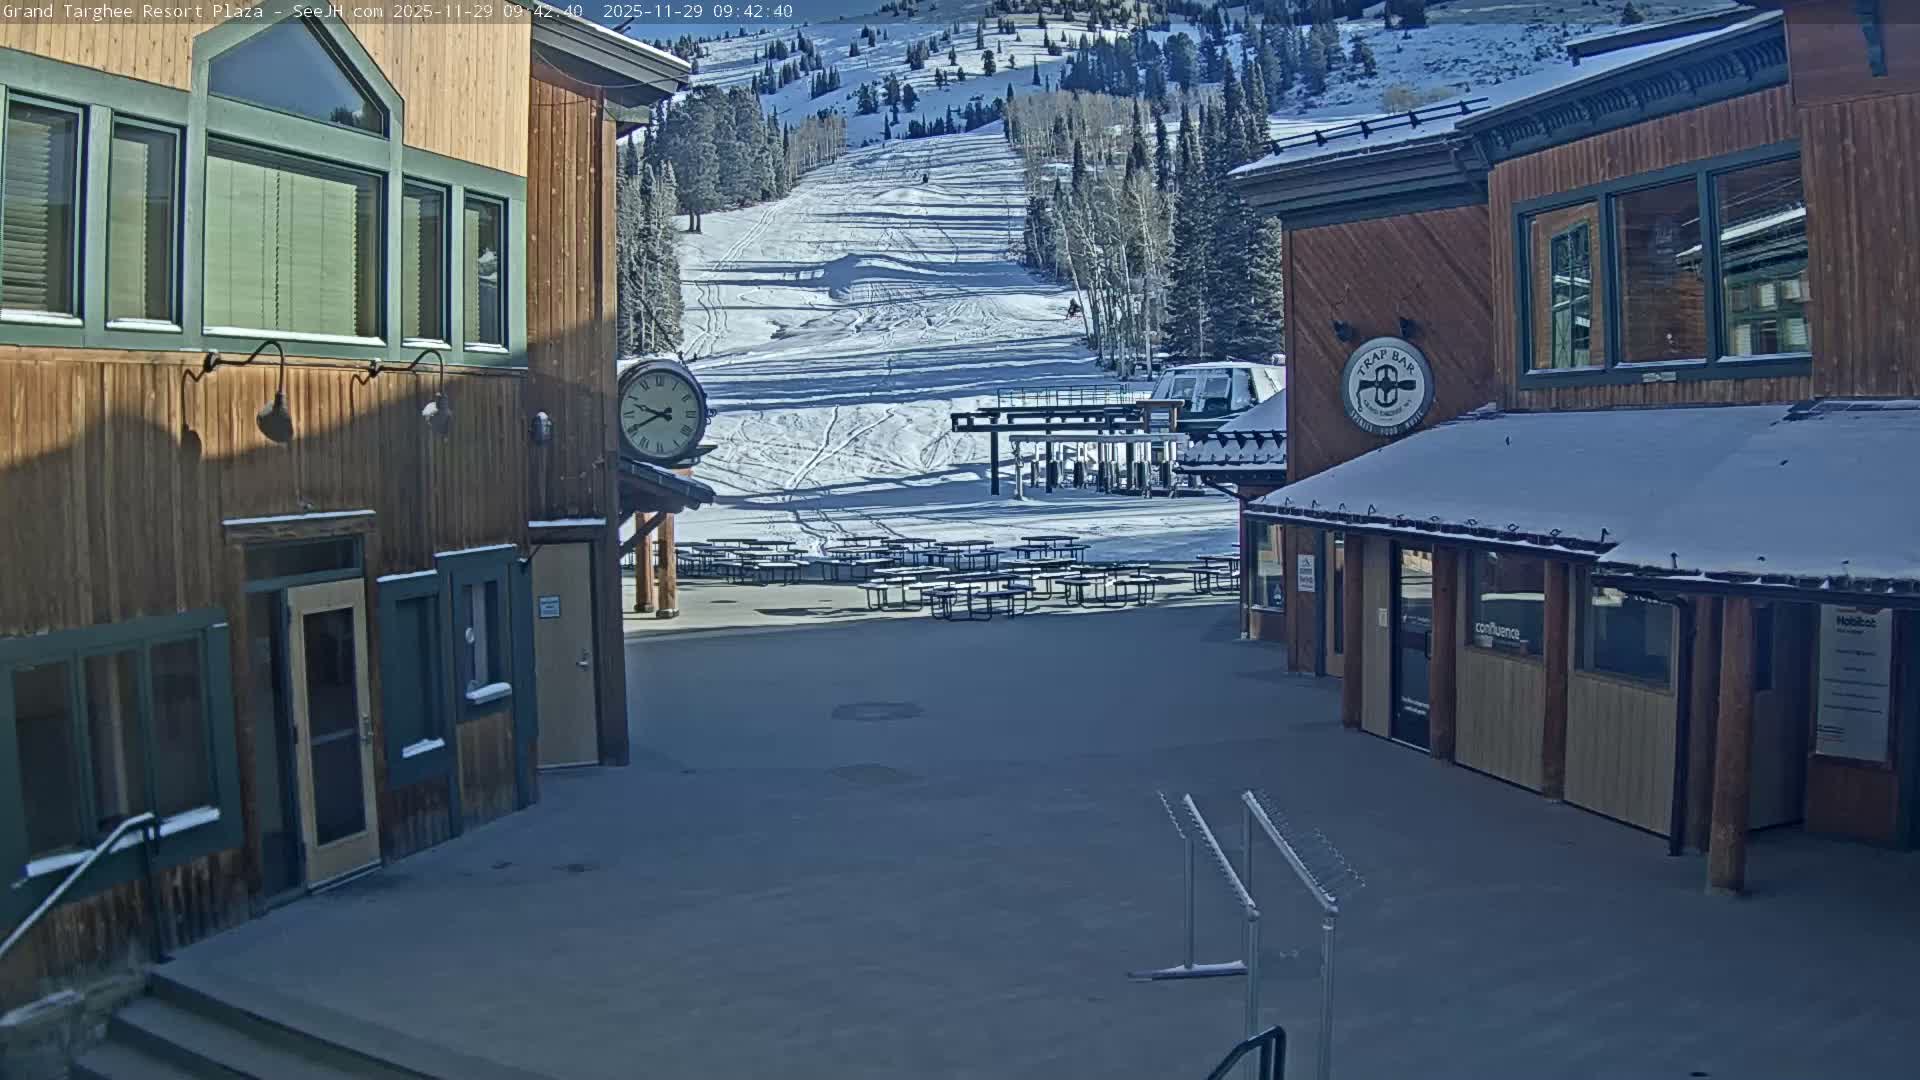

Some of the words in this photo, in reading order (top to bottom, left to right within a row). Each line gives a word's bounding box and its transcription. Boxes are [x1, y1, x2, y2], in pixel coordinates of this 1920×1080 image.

[1357, 349, 1388, 377] TRAP
[1392, 351, 1416, 376] BAR
[1475, 621, 1520, 640] confluence
[1836, 615, 1877, 628] Habitat
